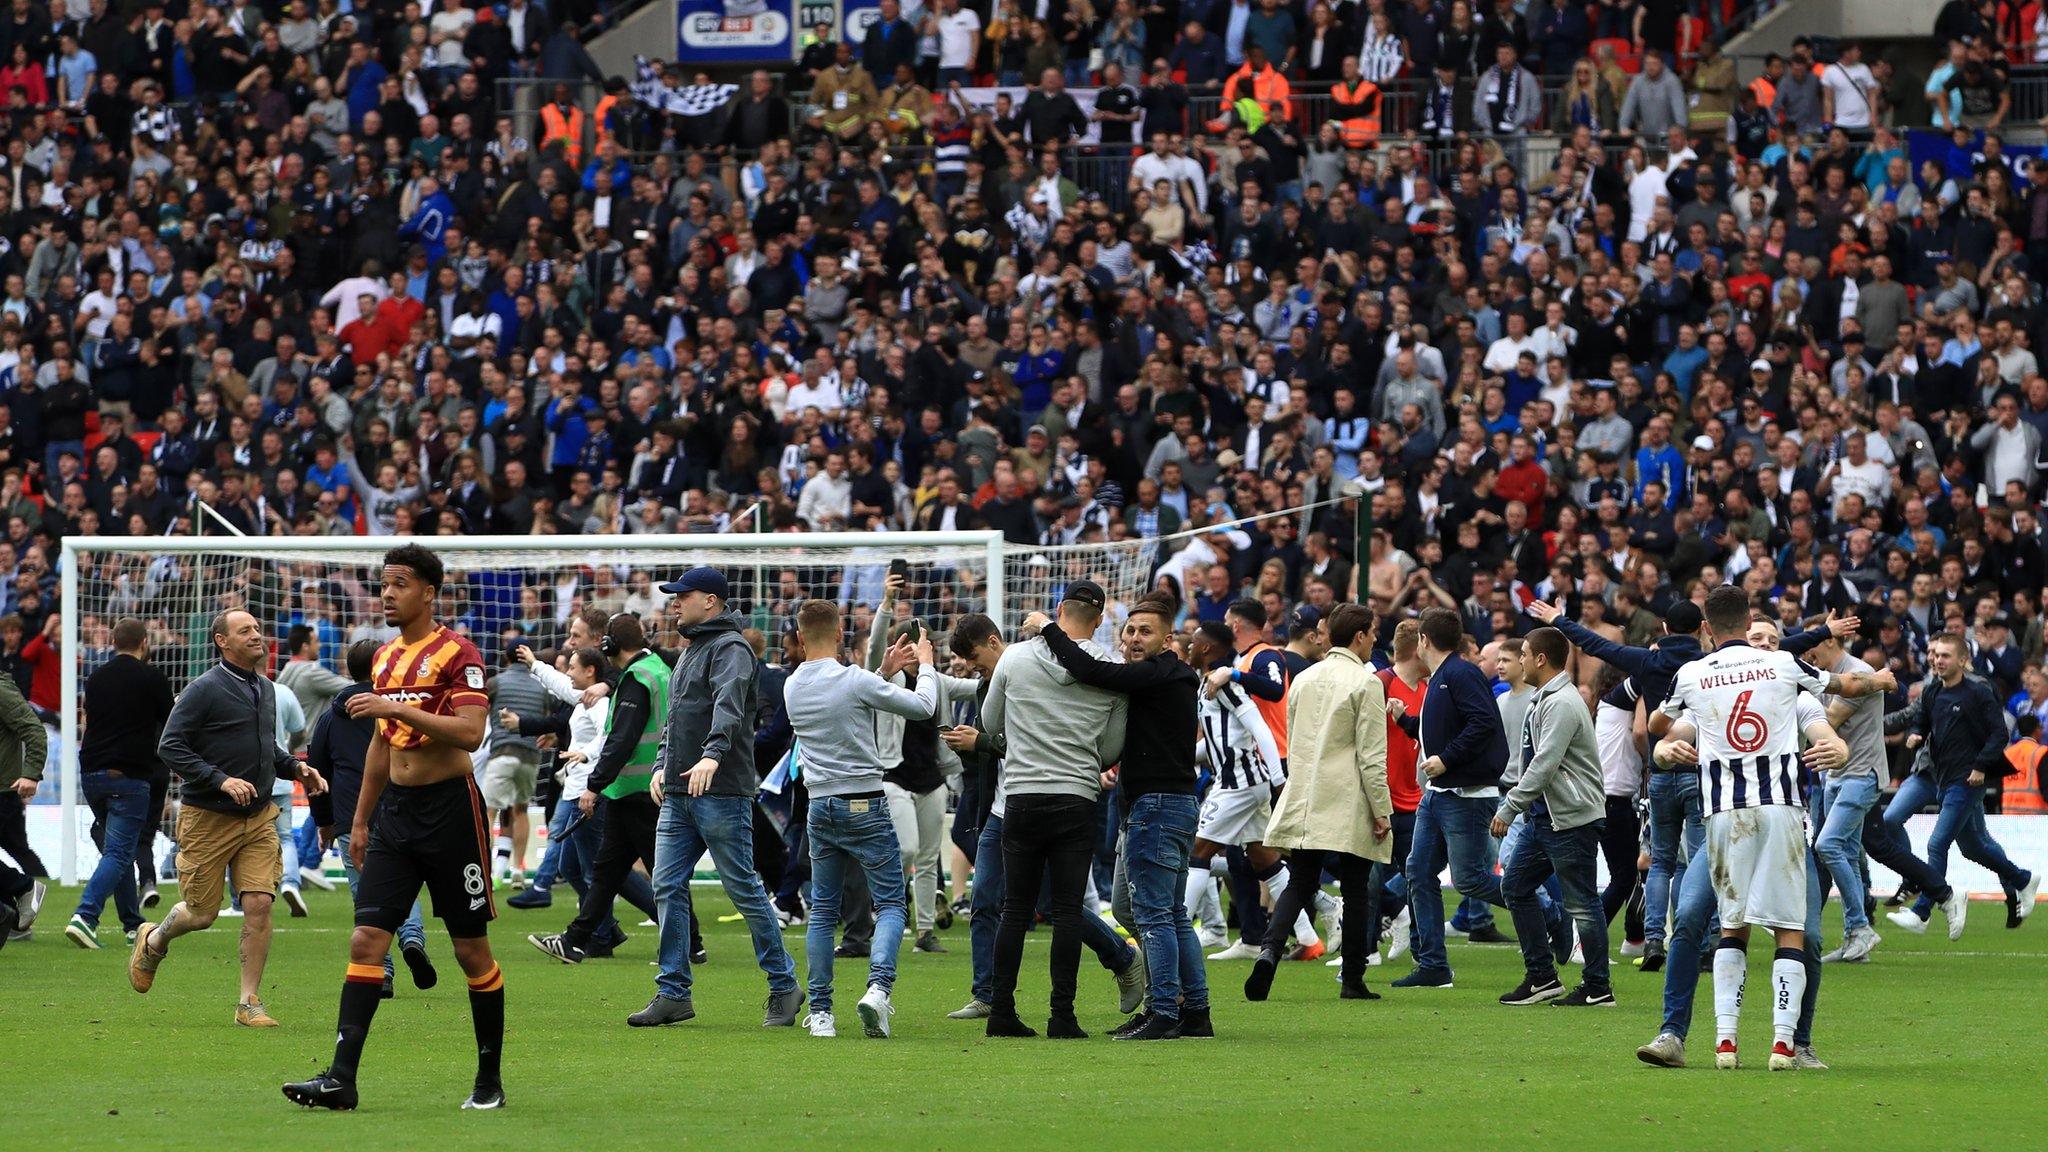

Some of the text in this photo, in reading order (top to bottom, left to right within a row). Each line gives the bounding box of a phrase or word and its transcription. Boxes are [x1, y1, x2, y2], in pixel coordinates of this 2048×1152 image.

[697, 18, 720, 31] SKY
[801, 6, 834, 24] 110
[1700, 667, 1777, 690] WILLIAMS
[1726, 690, 1769, 753] 6
[463, 863, 485, 895] 8
[1778, 976, 1790, 1011] LIONS
